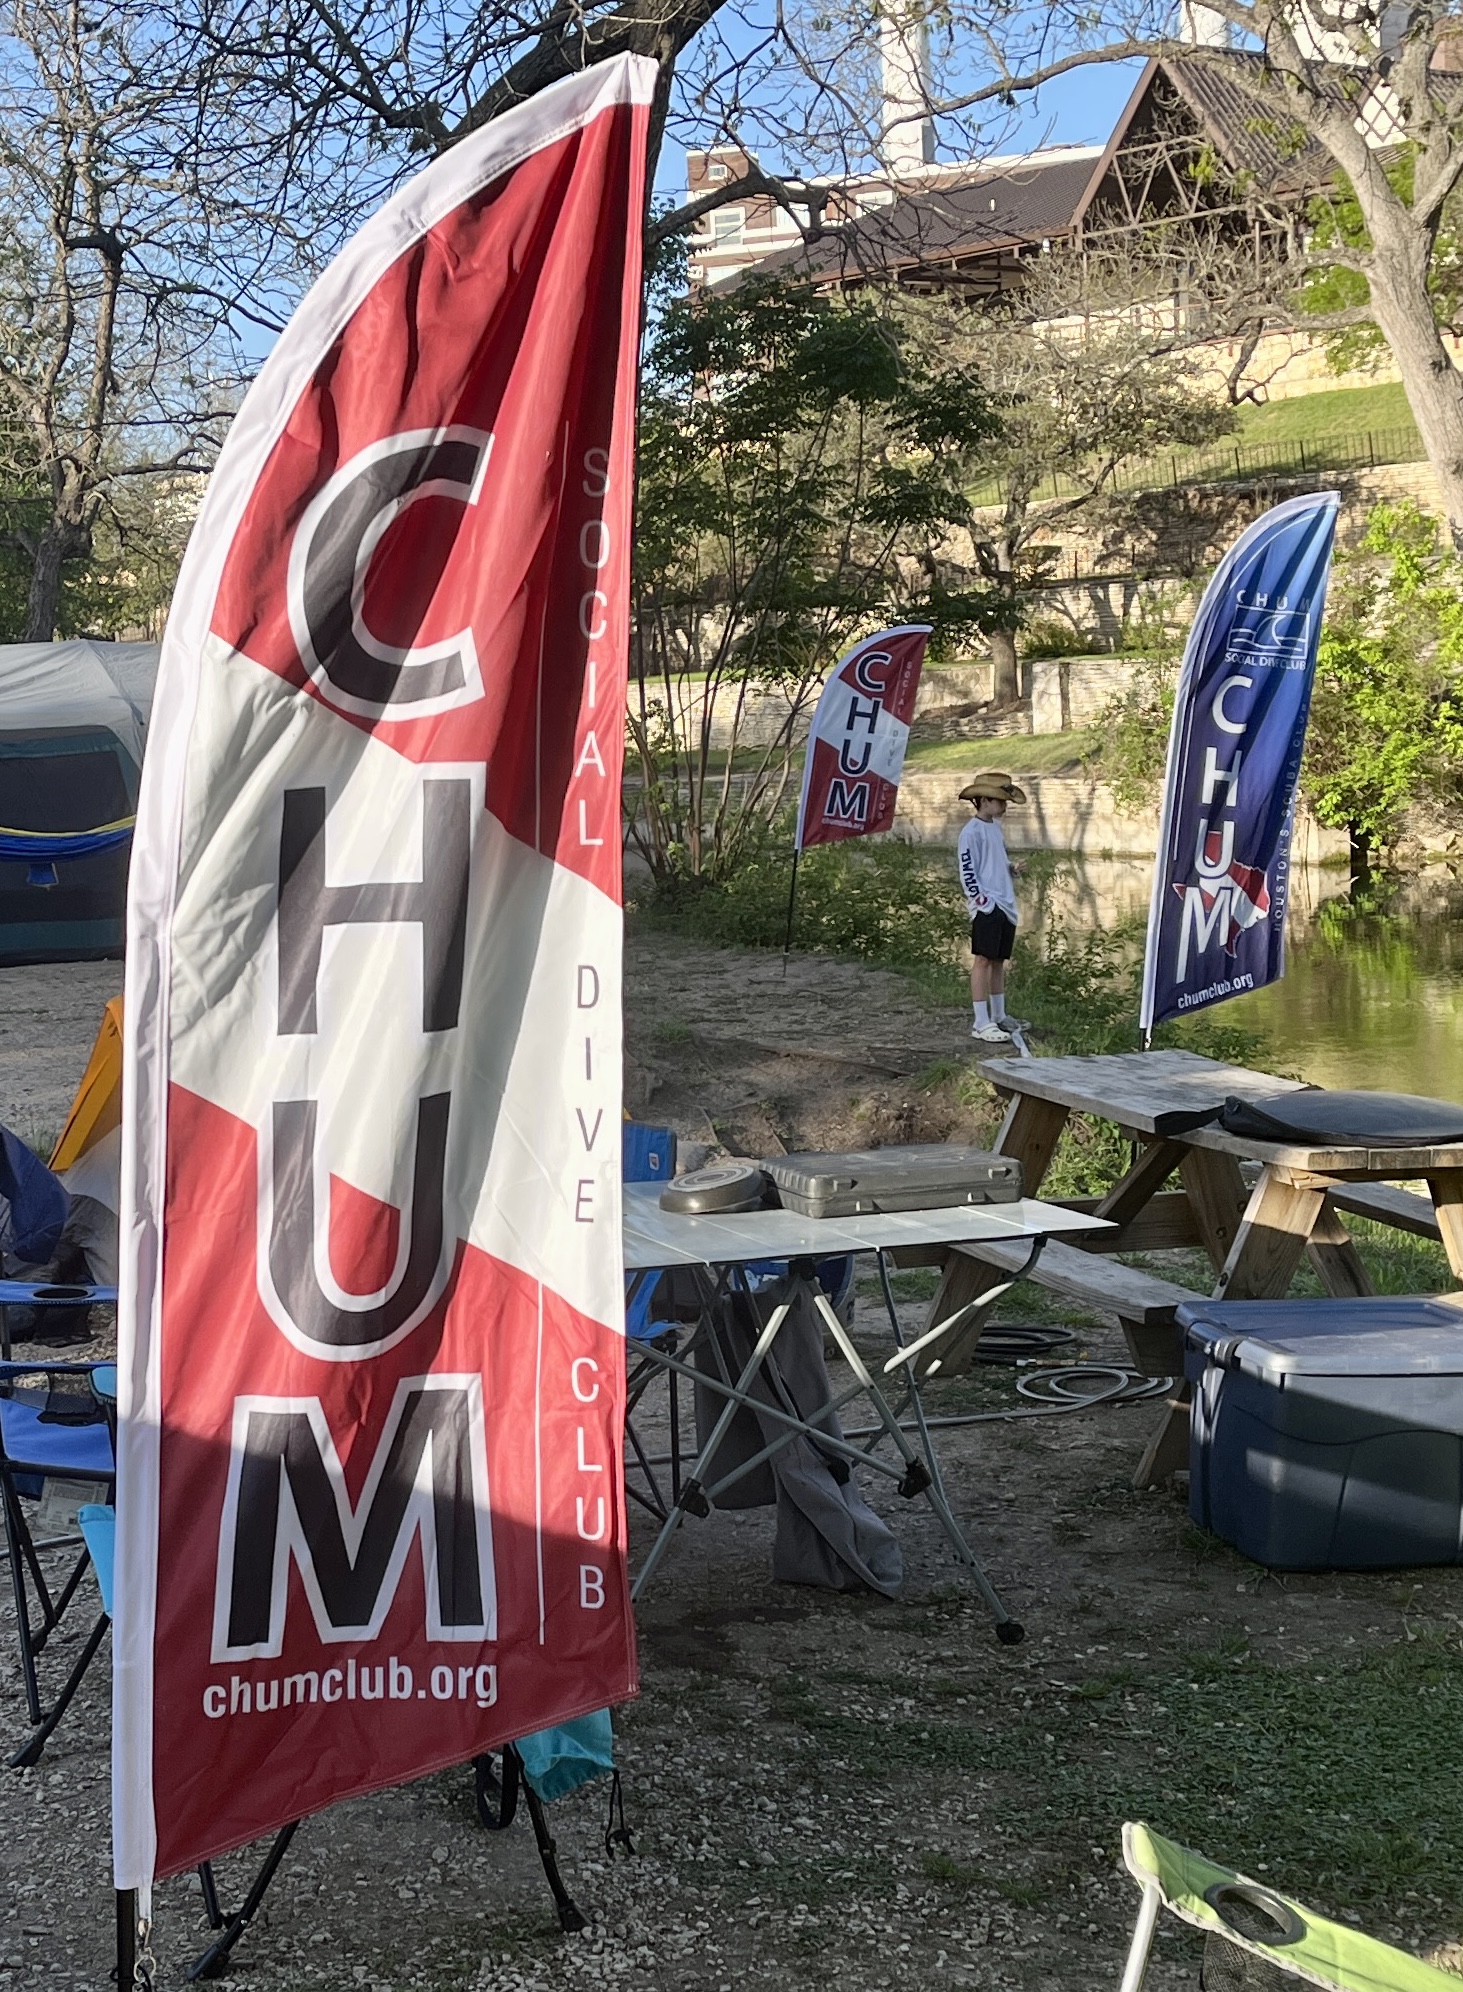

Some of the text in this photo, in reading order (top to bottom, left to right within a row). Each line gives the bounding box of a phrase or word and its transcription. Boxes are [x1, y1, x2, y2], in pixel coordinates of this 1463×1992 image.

[824, 651, 892, 822] CHUM
[877, 661, 913, 820] SOCIAL DIVE CLUB
[1281, 759, 1298, 818] SCUBA
[961, 848, 980, 898] COZUMEL
[1176, 675, 1253, 984] CHUM
[1274, 829, 1290, 932] HOUSTON'S
[210, 424, 497, 1664] CHUM
[571, 447, 611, 1609] SOCIAL DIVE CLUB
[1177, 973, 1254, 1009] chumclub.org
[203, 1656, 497, 1719] chumclub.org
